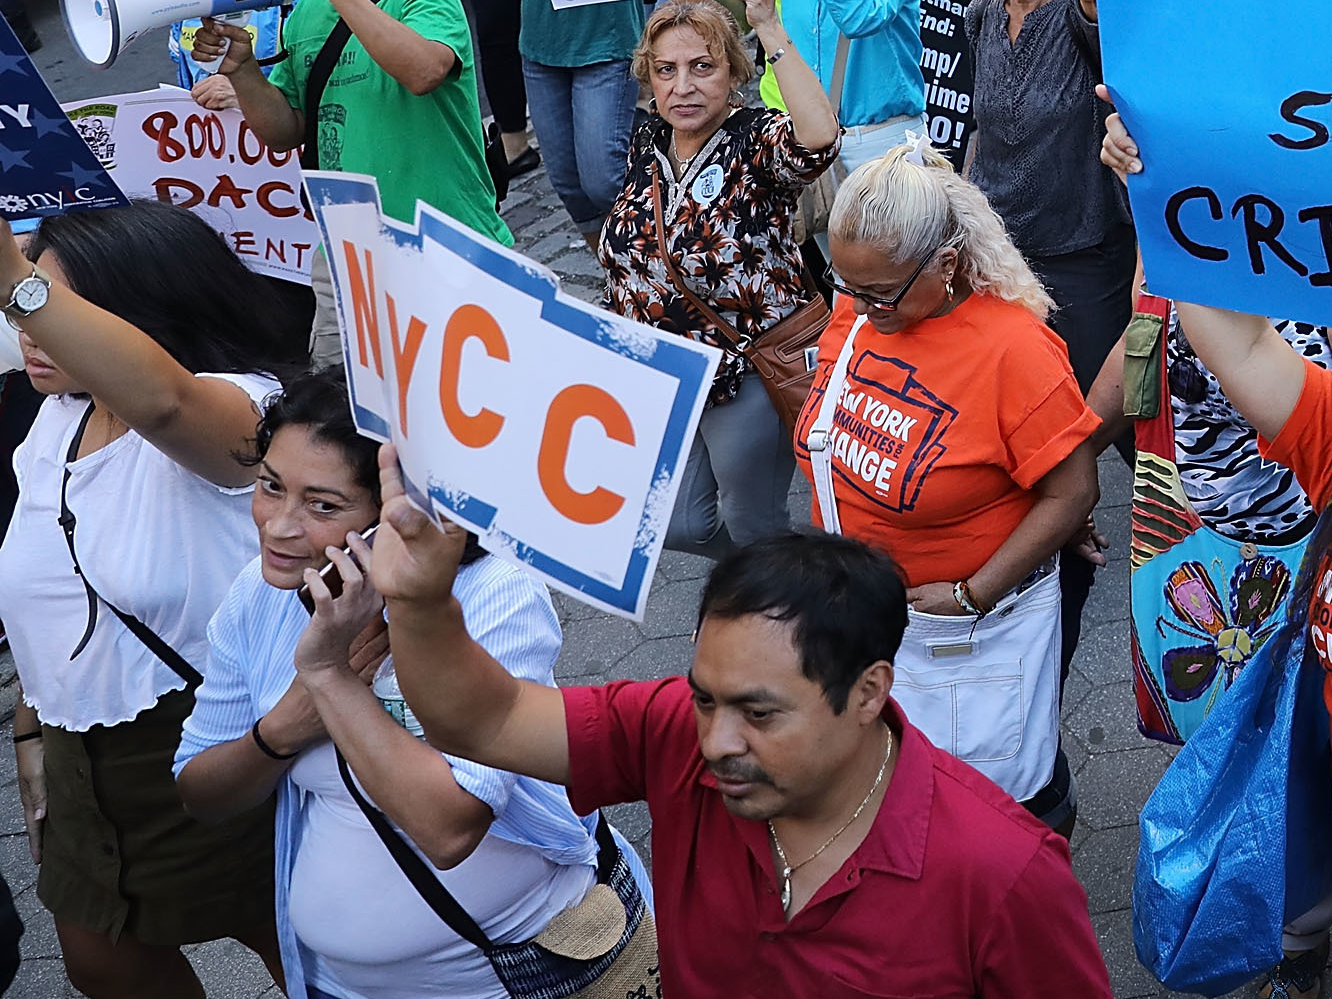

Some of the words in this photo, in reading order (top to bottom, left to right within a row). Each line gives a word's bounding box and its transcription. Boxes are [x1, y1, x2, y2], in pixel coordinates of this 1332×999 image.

[342, 239, 636, 525] NYCC
[833, 409, 895, 454] MMUNITIES
[862, 396, 918, 442] YORK
